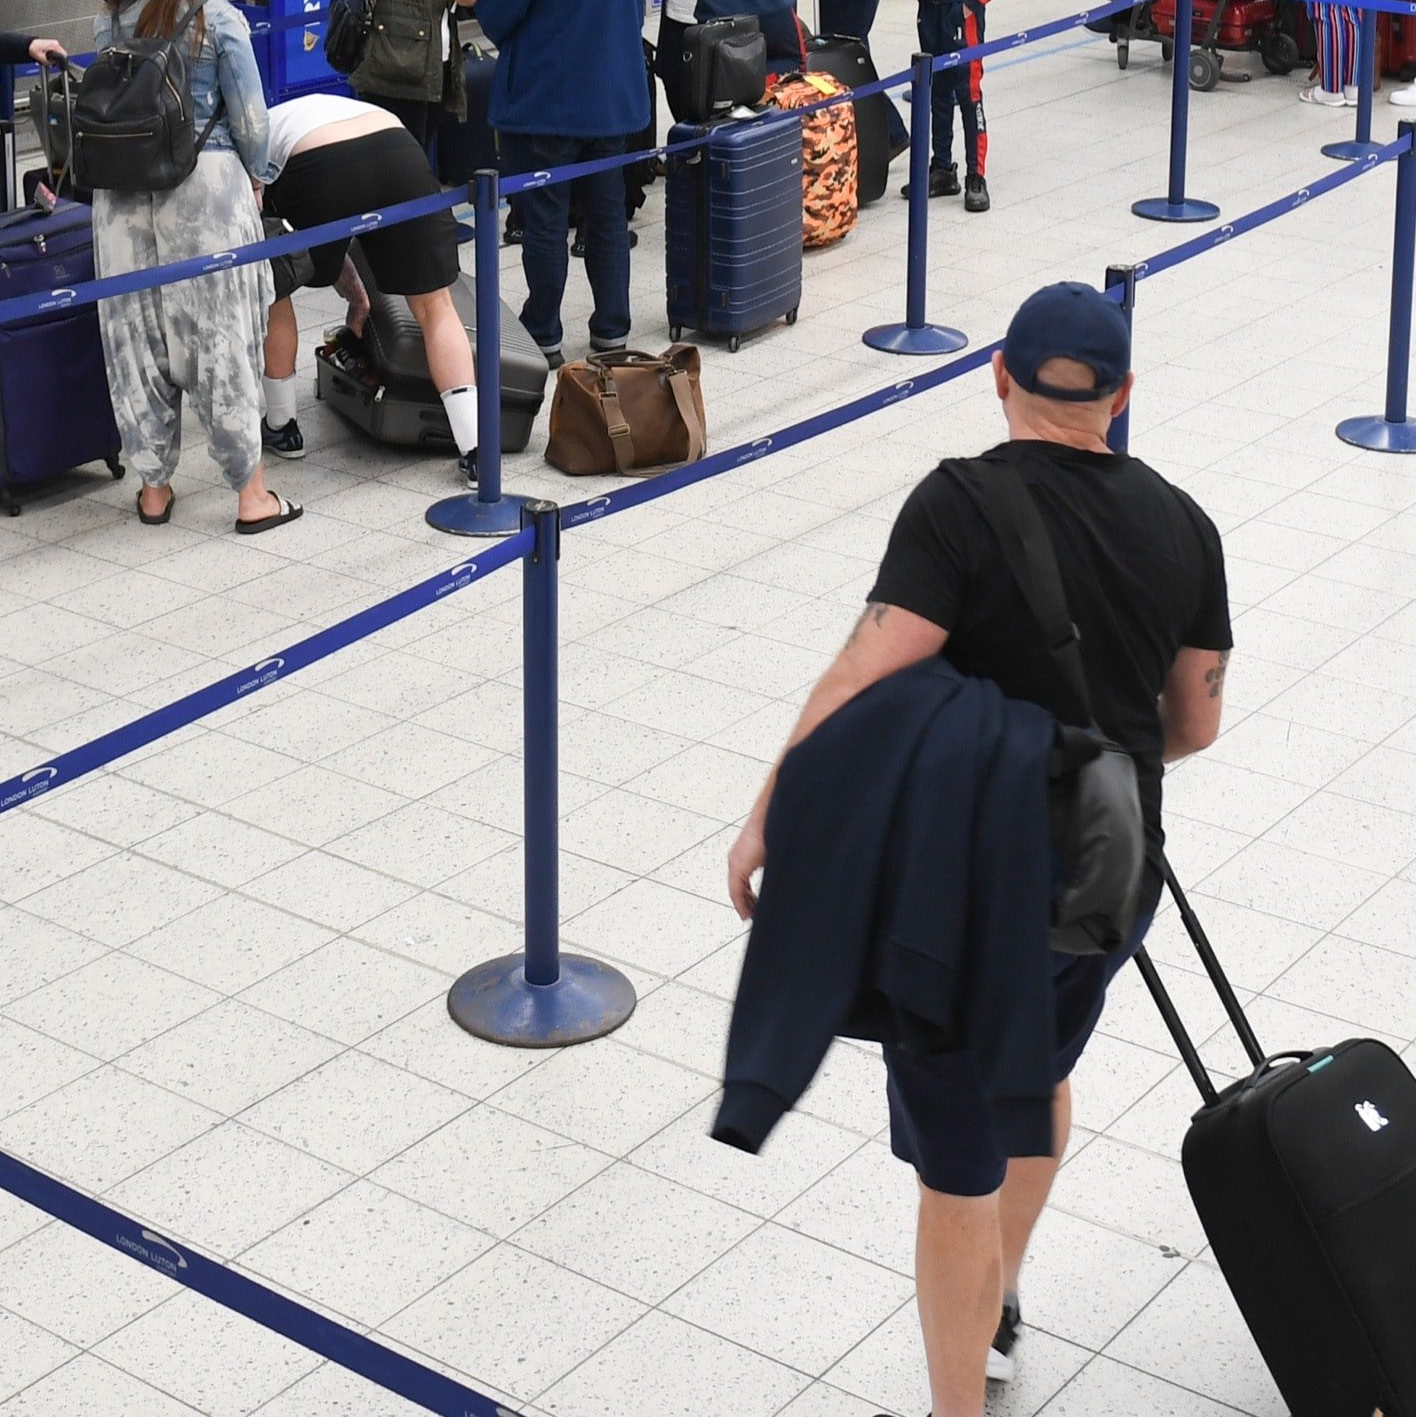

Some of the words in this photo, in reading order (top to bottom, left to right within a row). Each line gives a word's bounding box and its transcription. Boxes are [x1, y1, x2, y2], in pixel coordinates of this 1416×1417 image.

[435, 581, 455, 596] LONDON
[455, 573, 472, 586] LUTON
[236, 678, 260, 695] LONDON
[260, 668, 278, 683] LUTON
[0, 789, 27, 808] LONDON
[27, 779, 50, 794] LUTON
[115, 1234, 149, 1258] LONDON
[150, 1252, 178, 1272] LUTON
